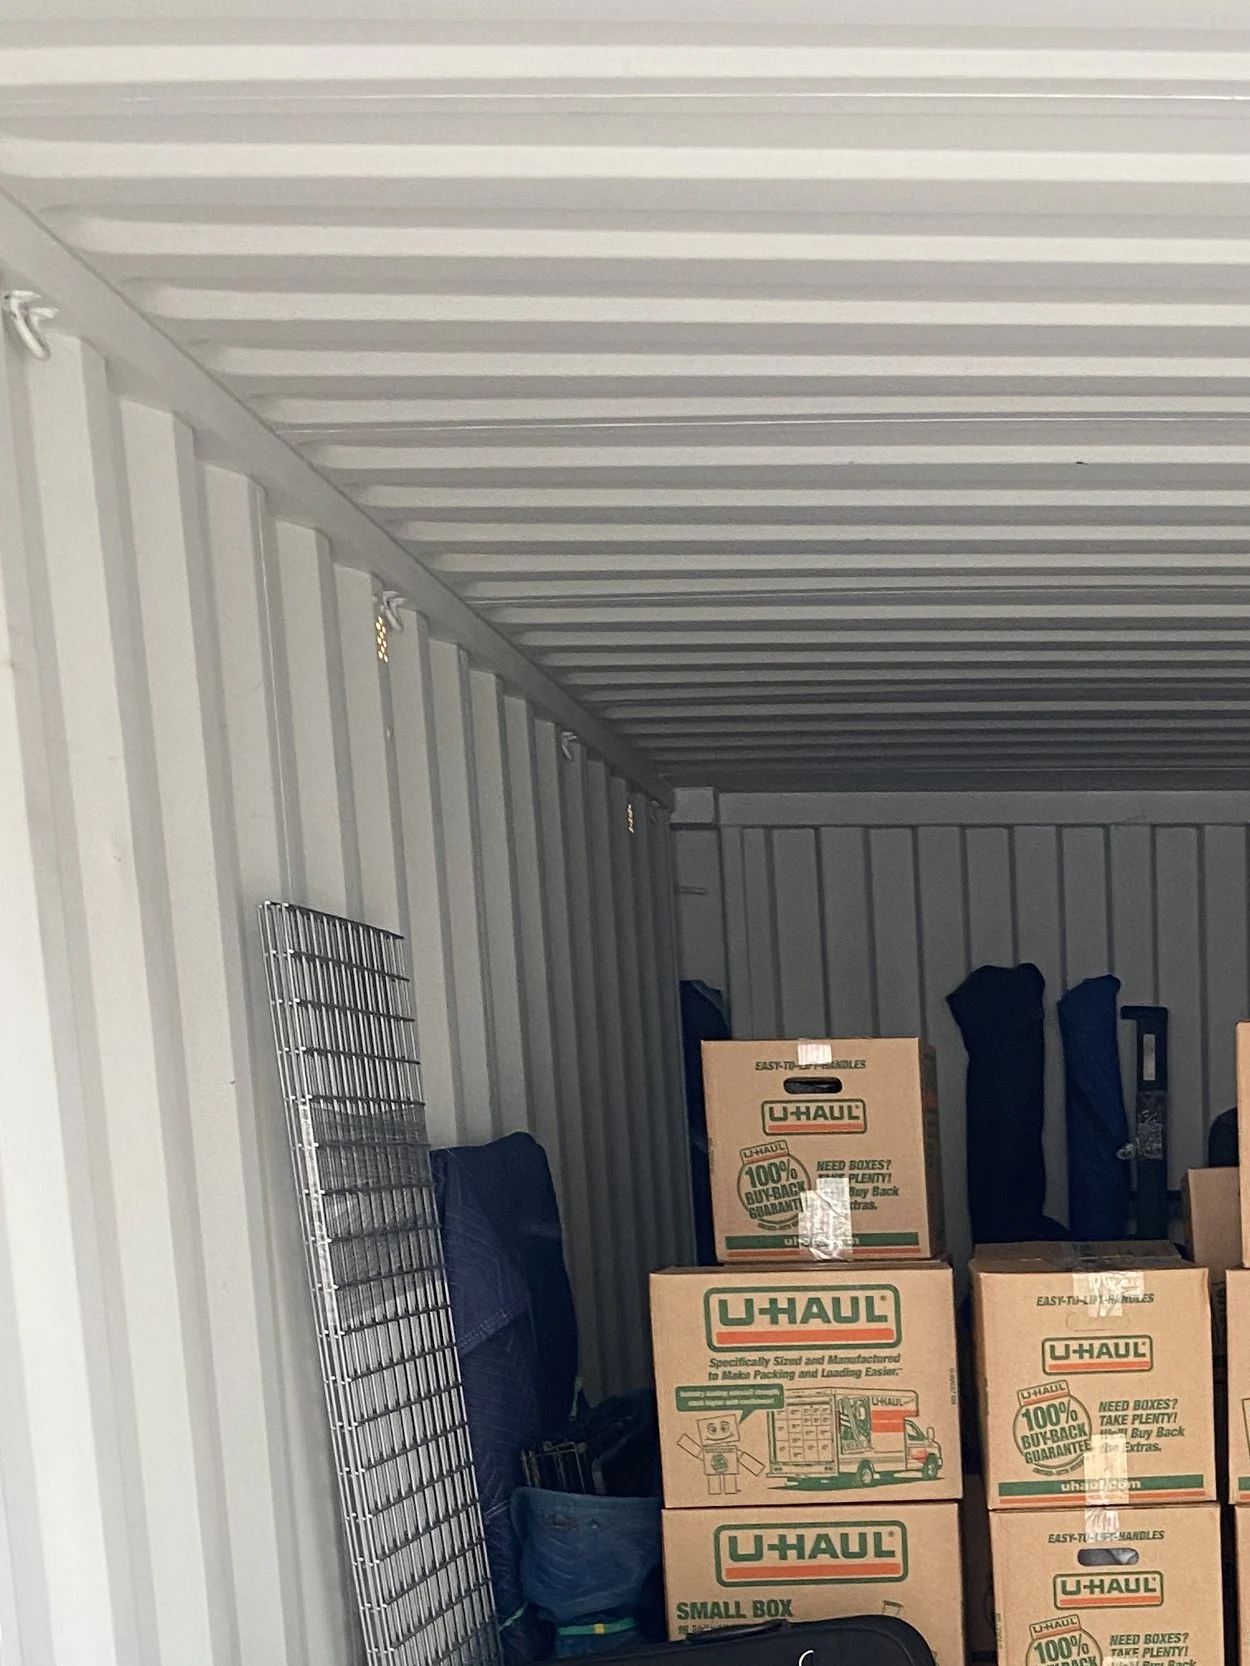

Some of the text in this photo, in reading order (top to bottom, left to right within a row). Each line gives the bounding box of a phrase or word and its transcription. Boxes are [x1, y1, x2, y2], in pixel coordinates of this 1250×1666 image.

[769, 1104, 860, 1122] U-HAUL
[745, 1158, 797, 1188] 100%
[817, 1160, 892, 1171] NEED BOXES?
[745, 1179, 807, 1207] BUY-BACK
[872, 1187, 899, 1197] Back
[718, 1296, 888, 1326] U-HAUL
[1050, 1342, 1147, 1360] U-HAUL
[710, 1354, 900, 1370] Specifically Sized and Manufactured
[708, 1372, 718, 1380] to
[722, 1370, 750, 1380] Make
[753, 1369, 794, 1380] Packing
[800, 1369, 818, 1378] and
[821, 1368, 862, 1379] Loading
[1020, 1383, 1066, 1399] U-HAUL
[1099, 1399, 1178, 1412] NEED BOXES?
[1022, 1400, 1077, 1431] 100%
[1100, 1412, 1177, 1425] TAKE PLENTY!
[1021, 1424, 1087, 1449] BUY-BACK
[1131, 1426, 1185, 1440] Buy Back
[1025, 1441, 1091, 1464] GUARANTEE
[728, 1531, 895, 1562] U-HAUL
[1061, 1577, 1157, 1595] U-HAUL
[677, 1600, 793, 1621] SMALL BOX
[1033, 1618, 1077, 1634] U-HAUL
[1034, 1633, 1089, 1664] 100%
[1110, 1633, 1189, 1646] NEED BOXES?
[1142, 1646, 1188, 1658] PLENTY!
